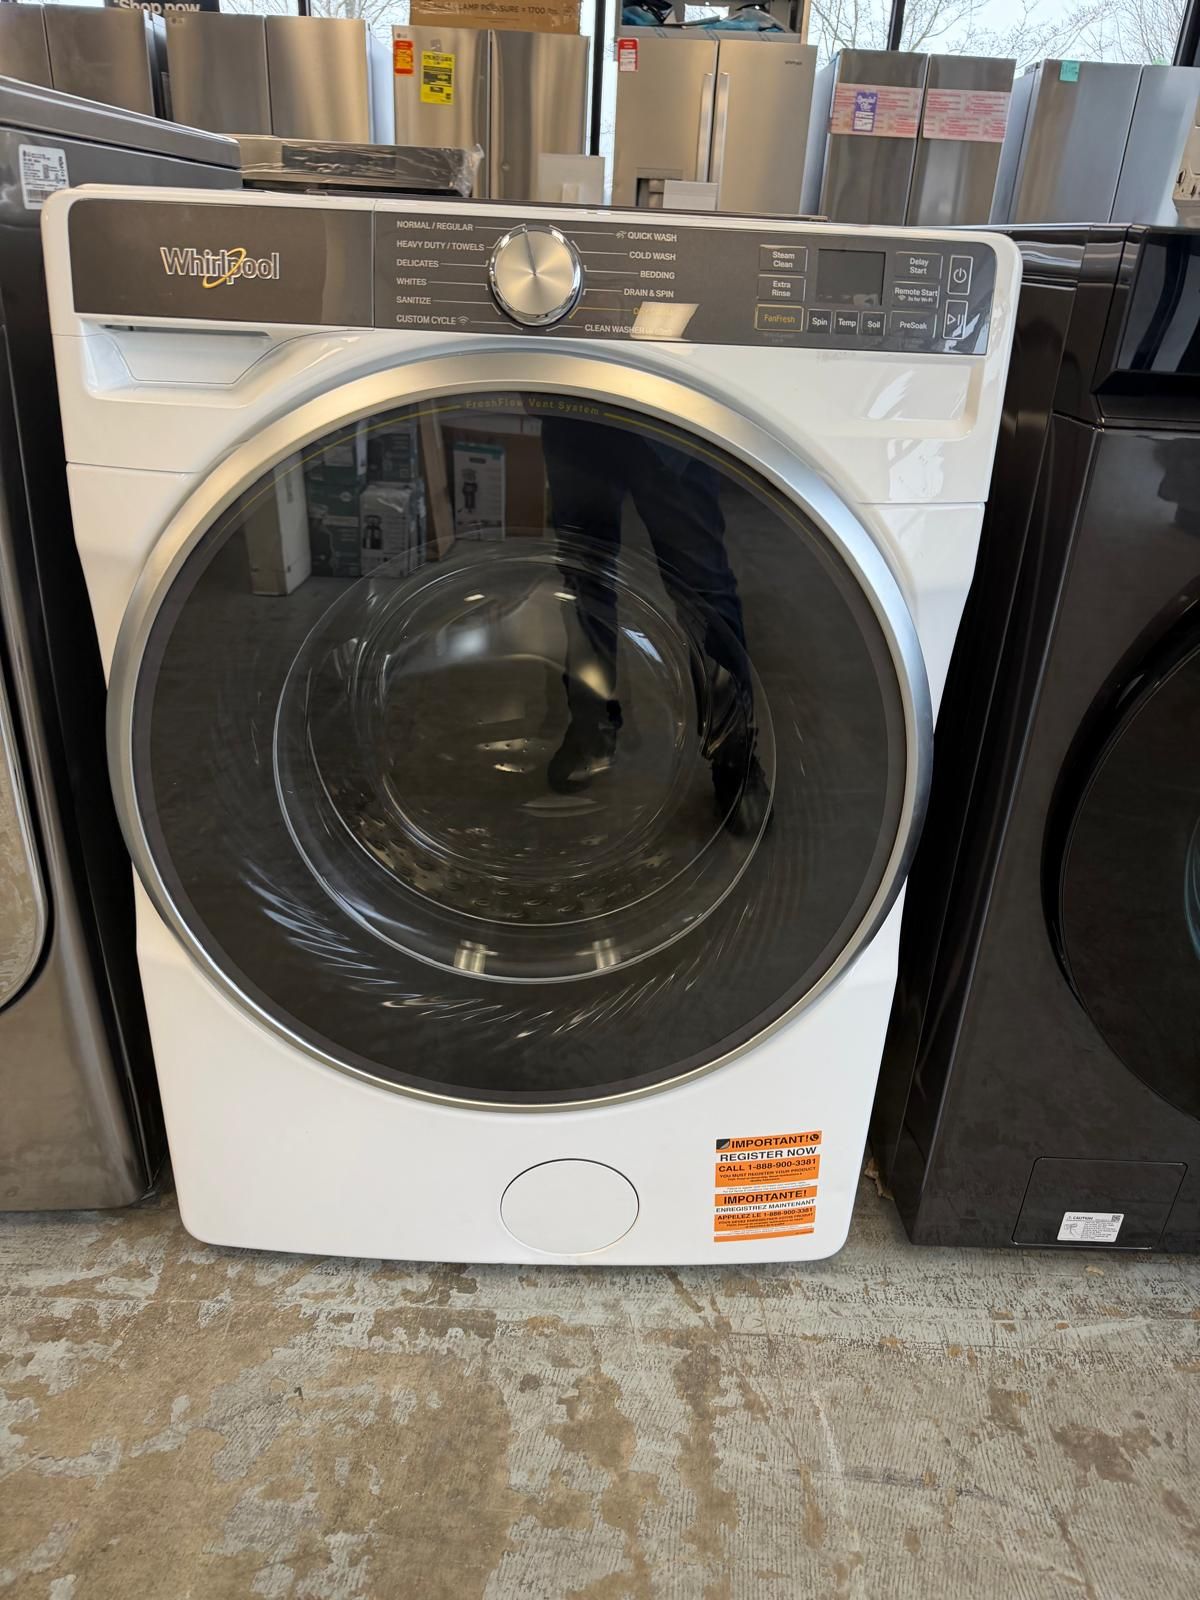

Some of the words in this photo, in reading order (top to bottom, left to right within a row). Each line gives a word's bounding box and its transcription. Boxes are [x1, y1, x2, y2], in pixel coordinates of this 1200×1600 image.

[396, 220, 431, 230] NORMAL
[436, 222, 474, 231] REGULAR
[627, 231, 653, 240] QUICK
[653, 232, 678, 242] WASH
[396, 240, 423, 249] HEAVY
[424, 241, 446, 249] DUTY
[451, 242, 485, 251] TOWELS
[629, 251, 652, 260] COLD
[652, 252, 677, 261] WASH
[772, 251, 796, 260] Steam
[159, 246, 280, 287] Whirlpool
[396, 259, 440, 268] DELICATES
[772, 260, 793, 268] Clean
[909, 257, 929, 267] Delay
[640, 270, 676, 280] BEDDING
[909, 266, 927, 275] Start
[396, 277, 428, 286] WHITES
[772, 280, 792, 289] Extra
[623, 288, 649, 297] DRAIN
[649, 289, 655, 297] &
[655, 289, 675, 298] SPIN
[771, 289, 792, 297] Rinse
[894, 287, 920, 296] Remote
[920, 288, 938, 297] Start
[396, 295, 432, 305] SANITIZE
[396, 314, 430, 324] CUSTOM
[431, 316, 457, 325] CYCLE
[764, 313, 796, 324] FanFresh
[811, 317, 828, 326] Spin
[837, 317, 857, 328] Temp
[584, 323, 611, 333] CLEAN
[611, 325, 645, 335] WASHER
[867, 320, 881, 329] Soil
[899, 321, 928, 330] PreSoak
[465, 397, 524, 409] FreshFlow
[528, 398, 555, 409] Vent
[558, 401, 599, 415] System
[731, 1135, 809, 1149] IMPORTANT!
[720, 1150, 783, 1162] REGISTER
[787, 1147, 817, 1157] NOW
[748, 1158, 816, 1170] 1-888-900-3381
[723, 1189, 807, 1205] IMPORTANTE!
[716, 1204, 767, 1213] ENREGISTREZ
[768, 1199, 816, 1209] MAINTENANT
[717, 1211, 751, 1220] APPELEZ
[752, 1210, 762, 1218] LE
